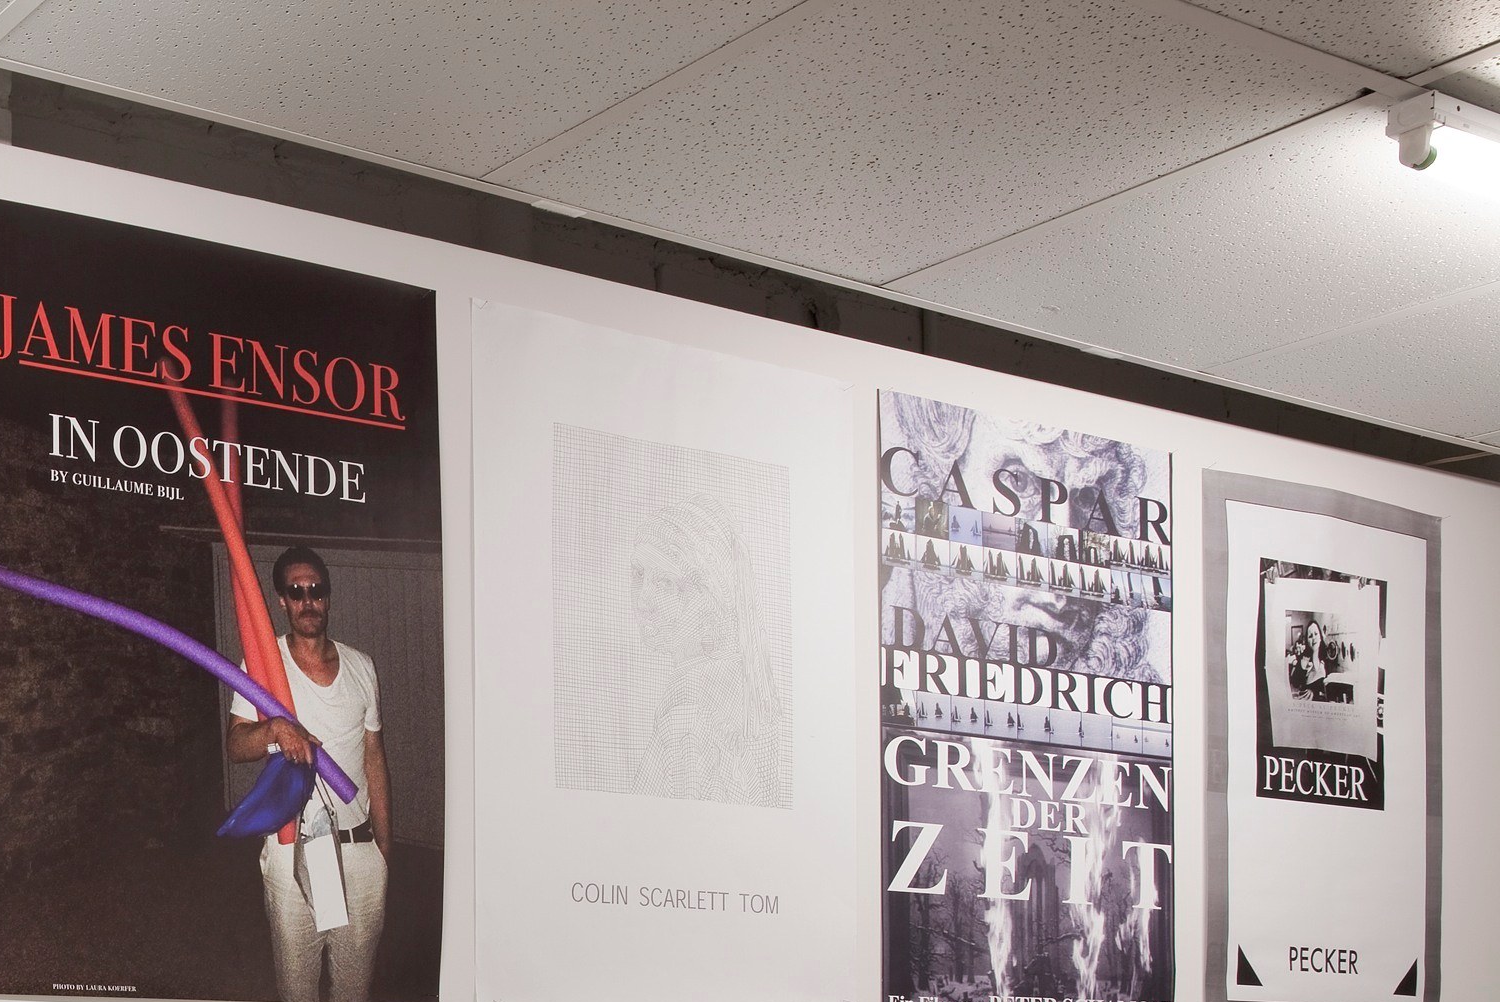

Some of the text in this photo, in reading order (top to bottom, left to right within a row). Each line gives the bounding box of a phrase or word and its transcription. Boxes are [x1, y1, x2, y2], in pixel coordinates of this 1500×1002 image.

[208, 332, 406, 420] ENSOR
[49, 413, 367, 504] IN OOSTENDE
[50, 469, 185, 500] BY GUILLAUME BIJL
[880, 447, 1171, 545] CASPAR
[889, 605, 1058, 668] DAVID
[880, 649, 1173, 724] FRIEDRICH
[884, 735, 1172, 812] GRENZEN
[1263, 755, 1368, 801] PECKER
[1009, 797, 1089, 834] DER
[571, 882, 780, 915] COLIN SCARLETT TOM
[887, 819, 1172, 910] ZEIT
[1289, 946, 1358, 974] PECKER
